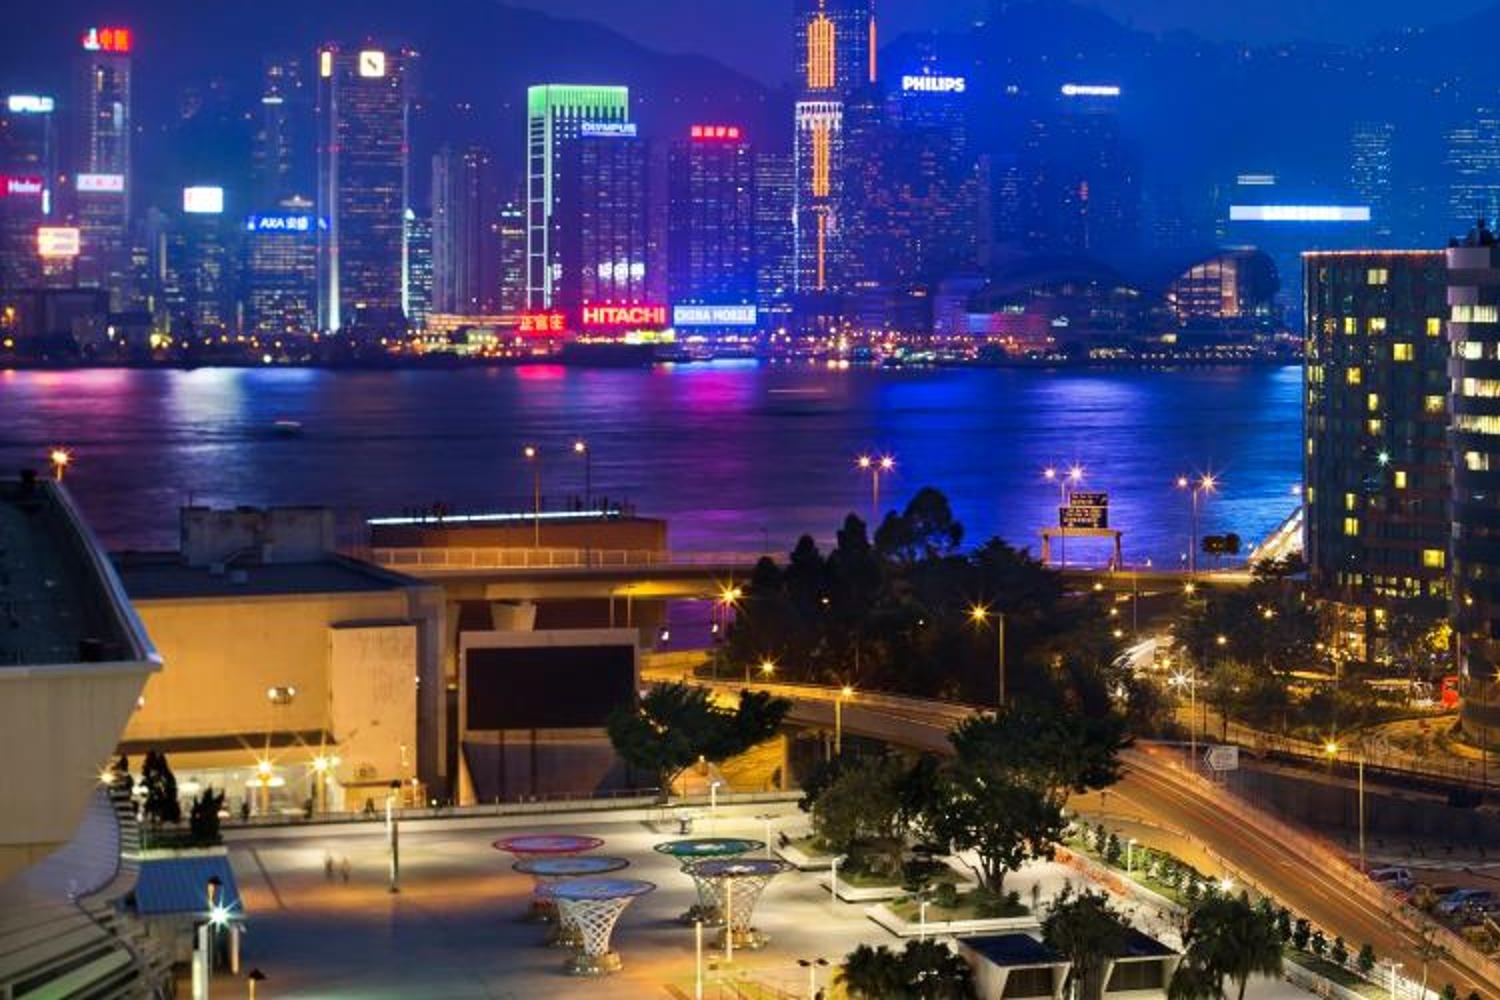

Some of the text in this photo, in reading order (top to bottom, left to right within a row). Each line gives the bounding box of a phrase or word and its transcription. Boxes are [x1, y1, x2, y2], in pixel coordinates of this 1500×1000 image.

[902, 76, 965, 92] PHILIPS
[582, 122, 636, 134] OLYMPUS
[583, 307, 665, 323] HITACHI
